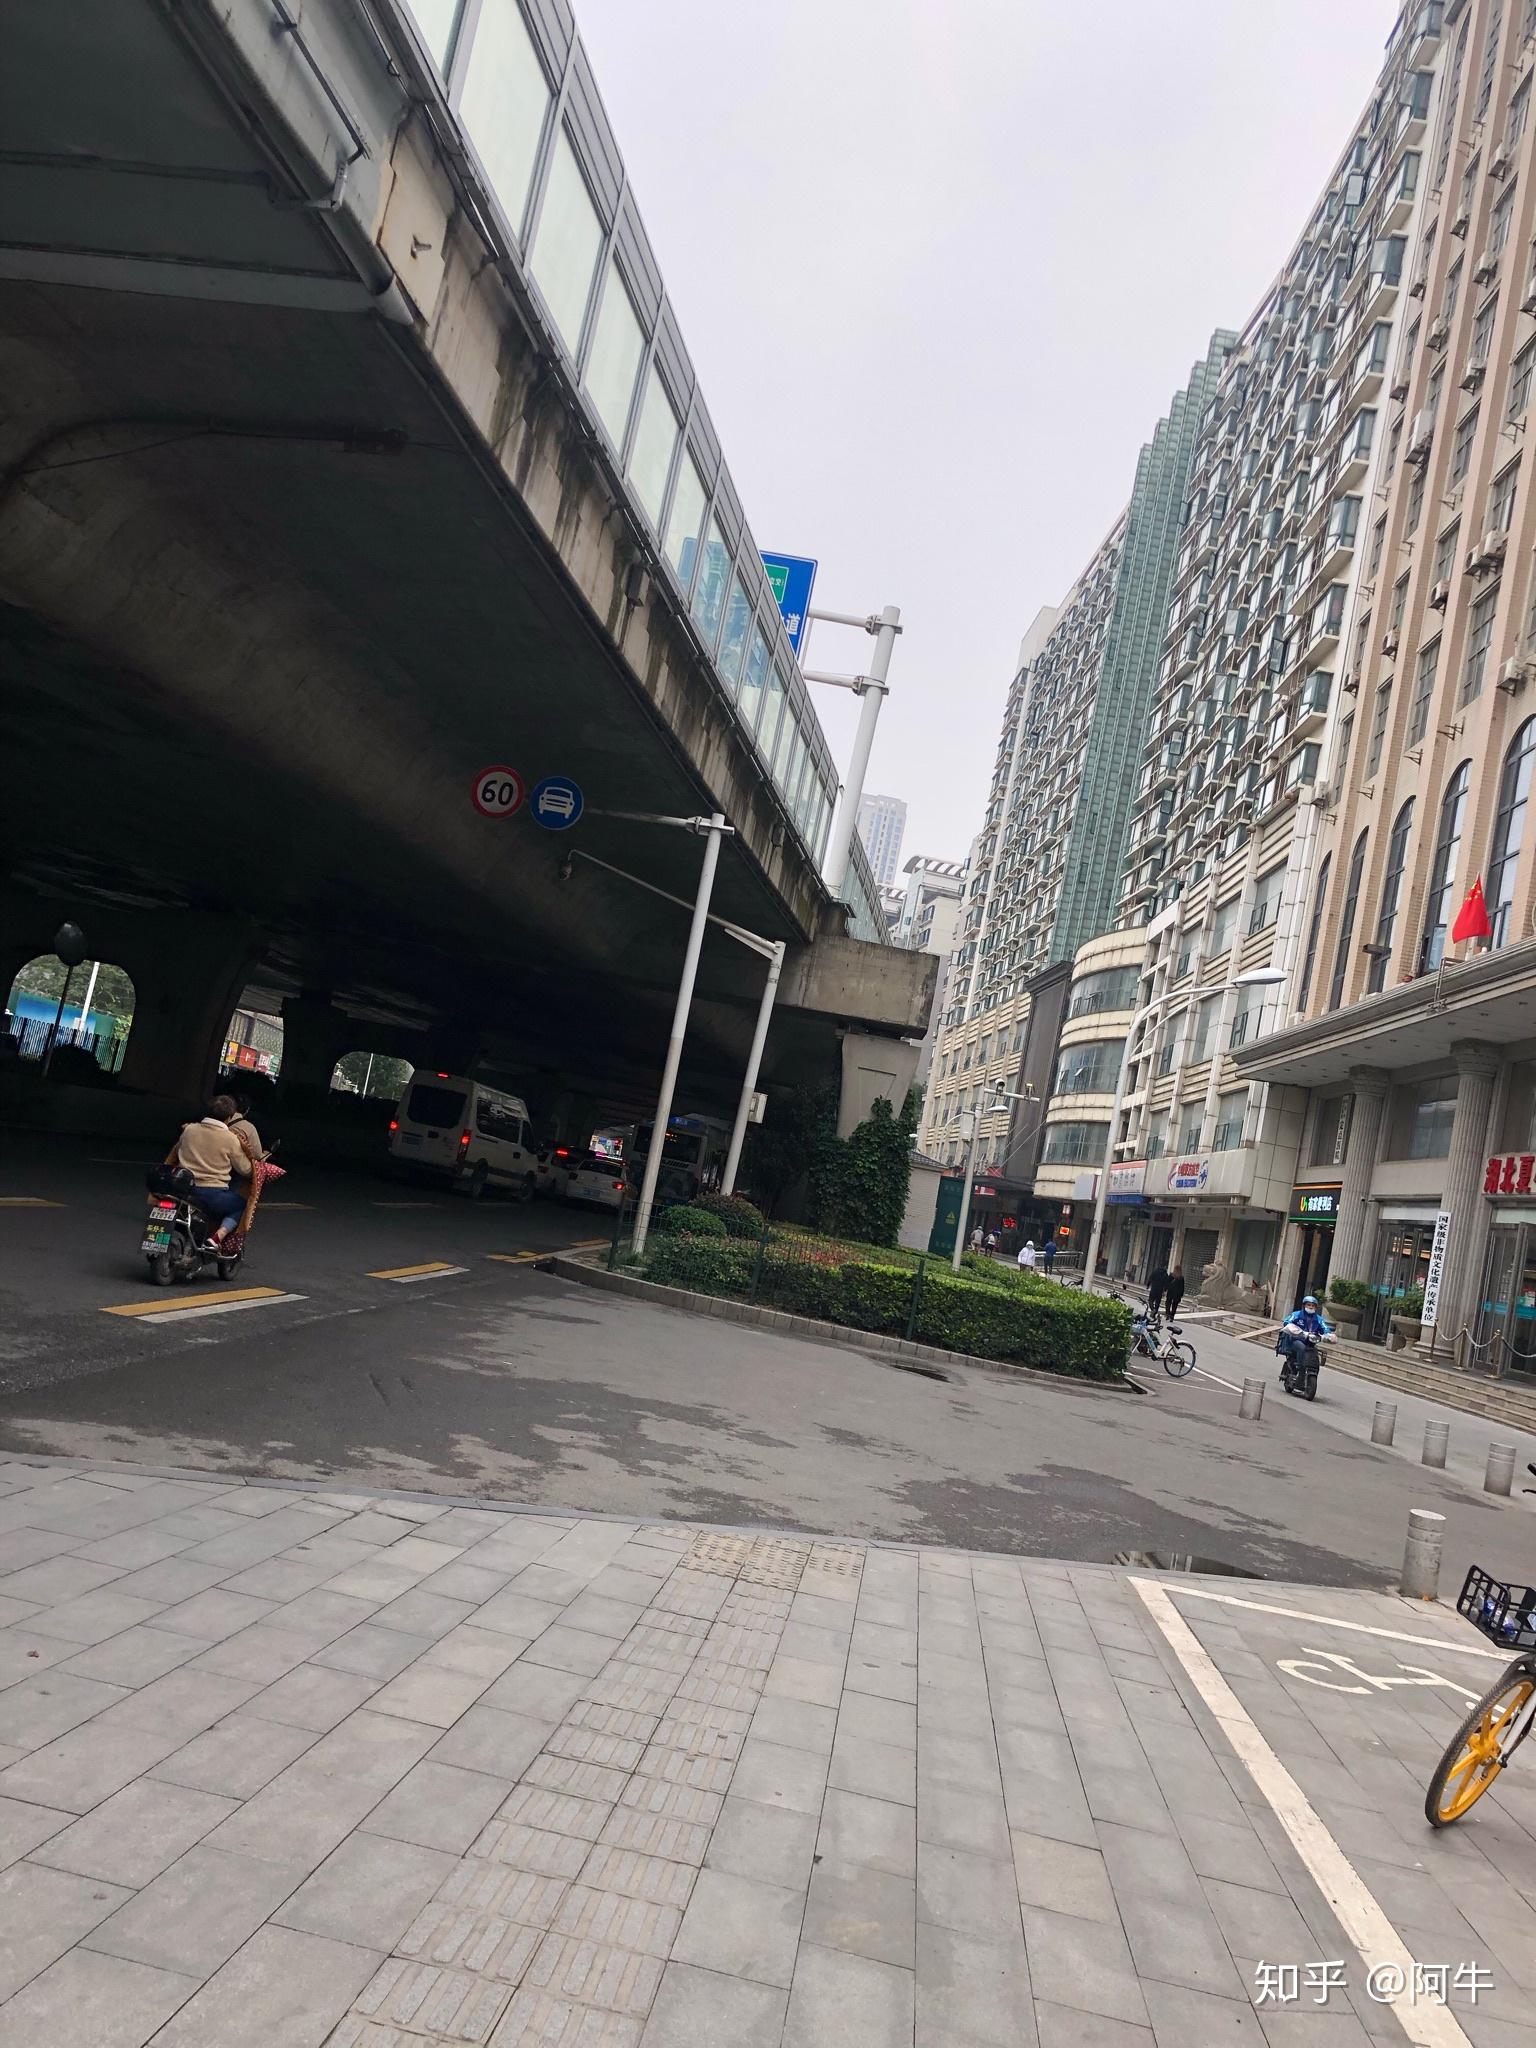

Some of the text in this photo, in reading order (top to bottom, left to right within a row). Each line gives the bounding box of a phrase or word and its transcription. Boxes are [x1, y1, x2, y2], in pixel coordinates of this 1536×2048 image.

[481, 780, 514, 806] 60
[1484, 1155, 1536, 1194] 湖北夏
[1424, 1216, 1448, 1321] 国家级非物质文化遗产传承单位
